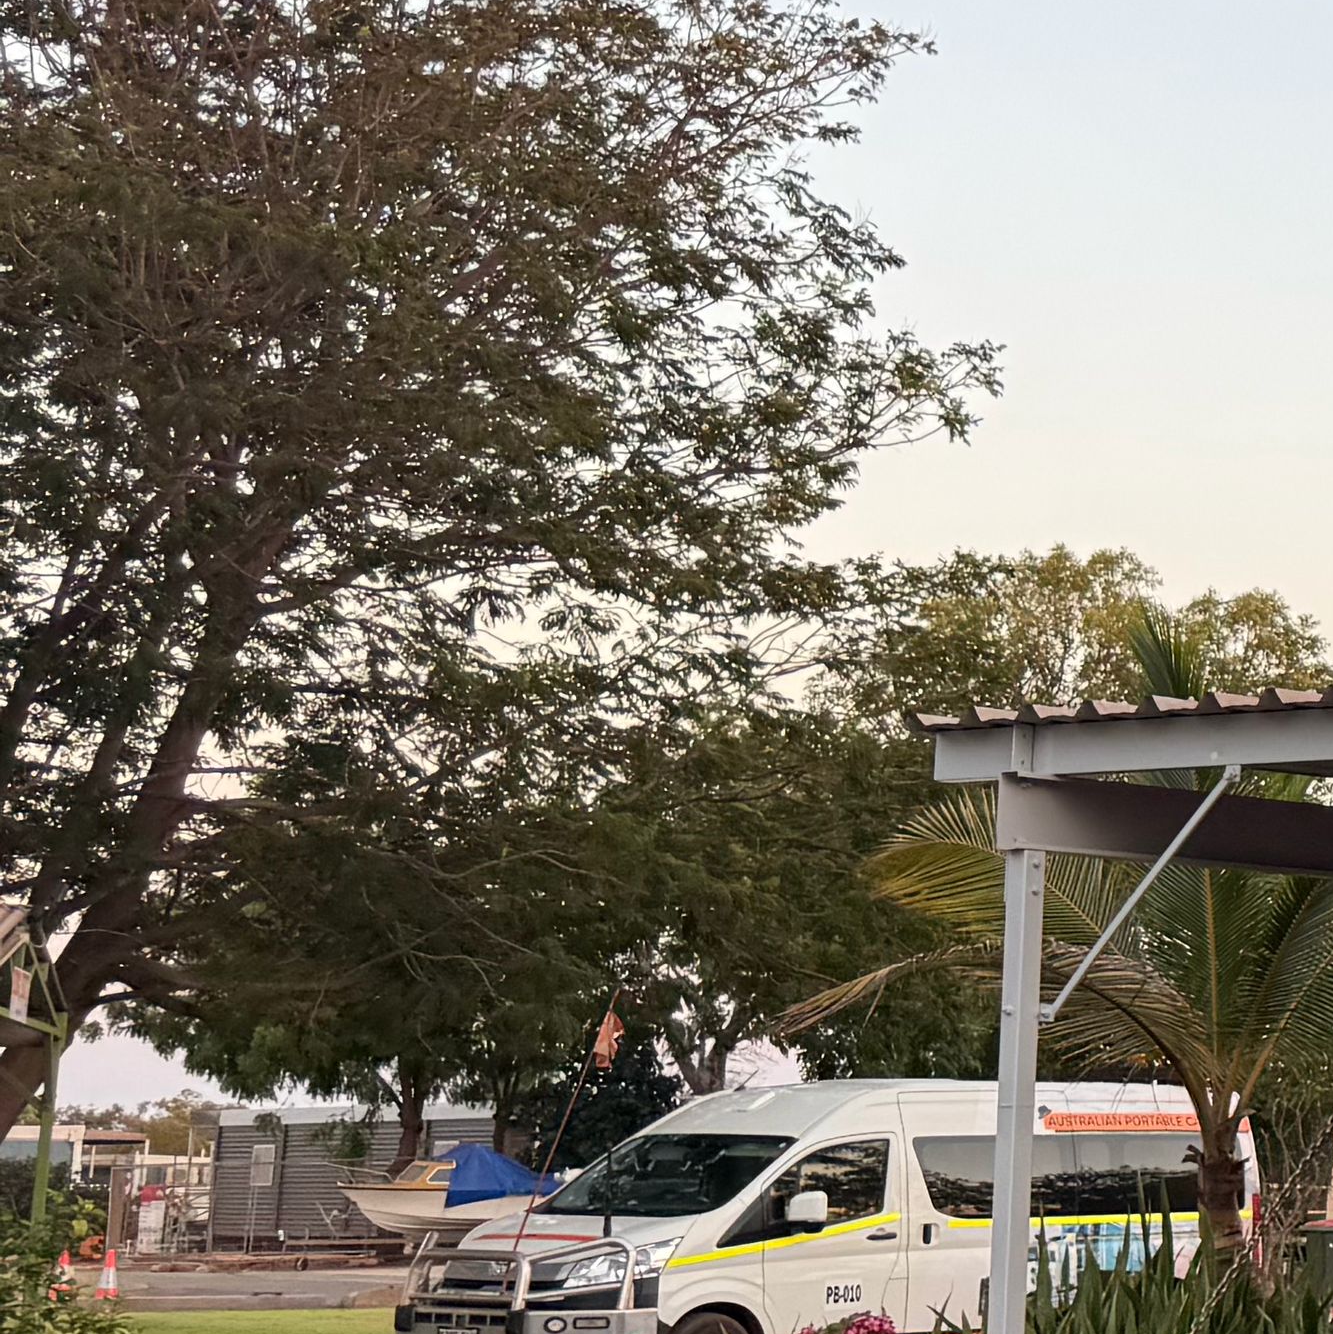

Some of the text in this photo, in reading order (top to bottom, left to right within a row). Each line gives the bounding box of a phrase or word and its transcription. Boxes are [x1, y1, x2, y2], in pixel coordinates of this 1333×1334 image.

[1048, 1116, 1123, 1127] AUSTRALIAN
[1125, 1116, 1183, 1127] PORTABLE
[826, 1284, 861, 1304] PB-010
